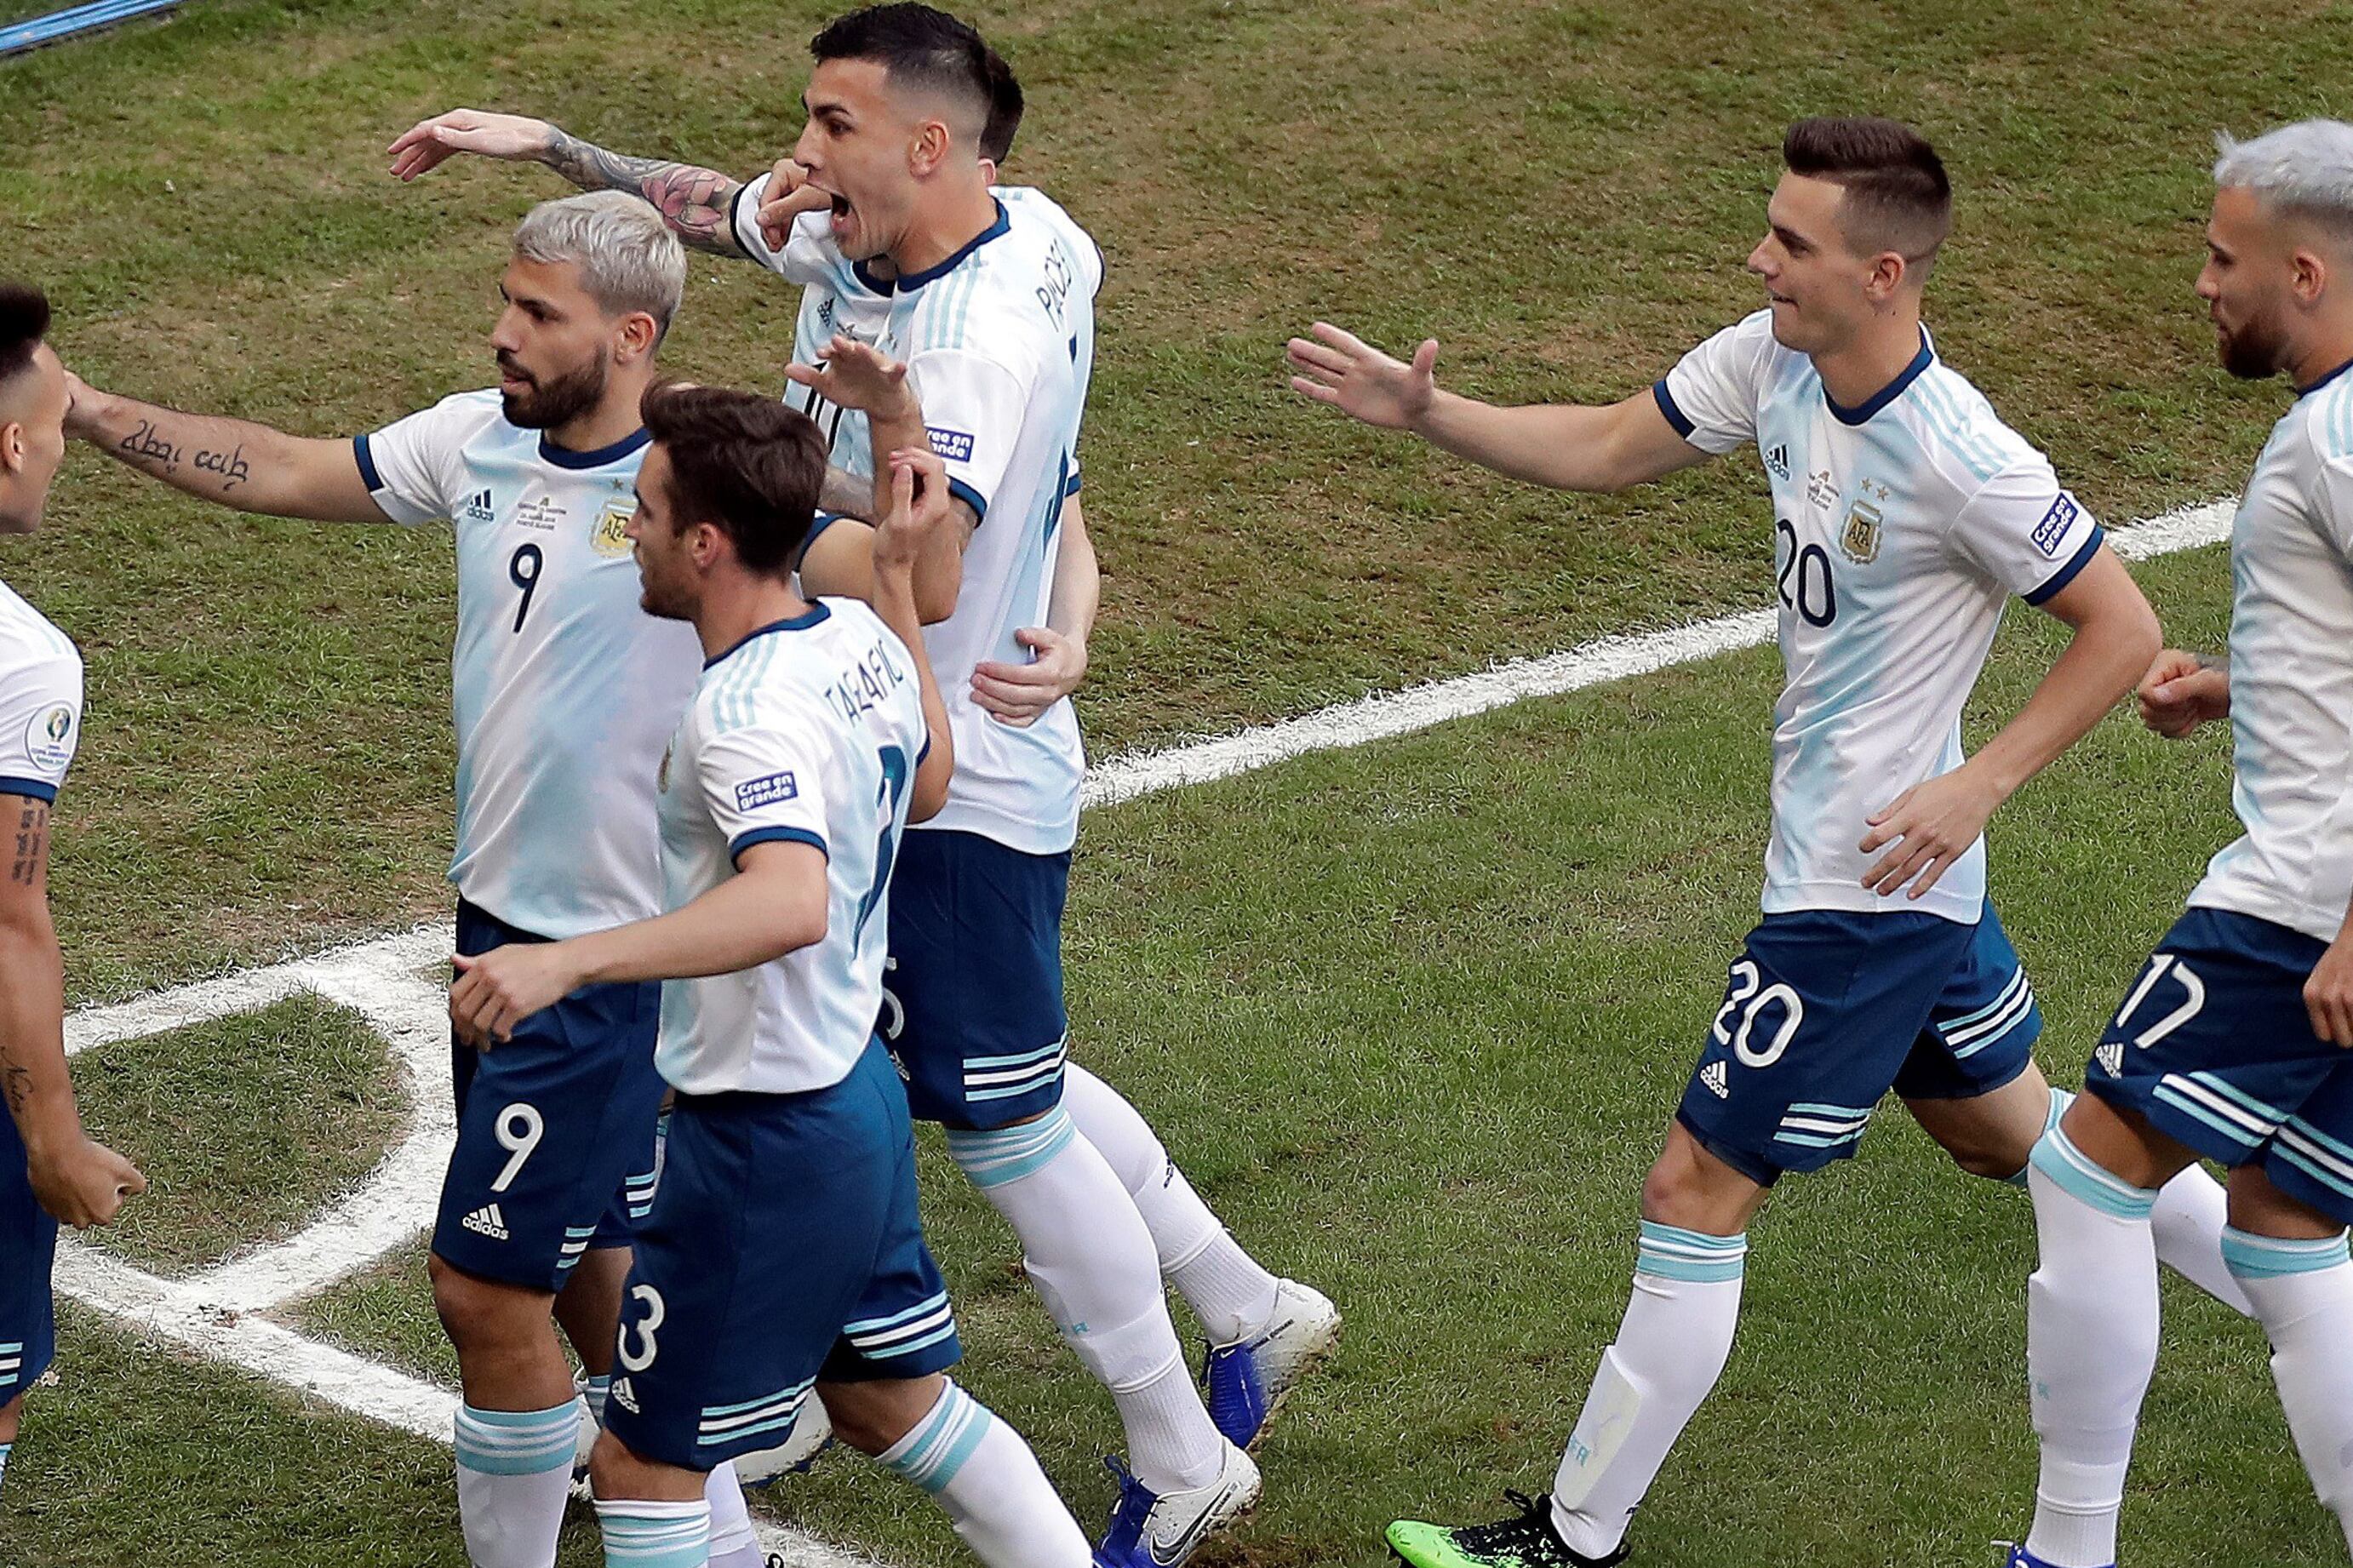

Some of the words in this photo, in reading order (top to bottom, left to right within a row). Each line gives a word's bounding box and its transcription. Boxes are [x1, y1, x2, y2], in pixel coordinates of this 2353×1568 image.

[2034, 513, 2058, 542] Cree
[2054, 498, 2068, 515] en
[2043, 508, 2073, 552] grande
[509, 542, 544, 633] 9
[1776, 518, 1837, 628] 20
[737, 779, 770, 797] Cree
[772, 775, 793, 787] en
[741, 785, 792, 810] grande
[1713, 960, 1803, 1067] 20
[2115, 953, 2205, 1049] 17
[1700, 1068, 1730, 1099] adidas
[489, 1102, 544, 1192] 9
[461, 1216, 509, 1240] adidas
[617, 1284, 665, 1372] 3
